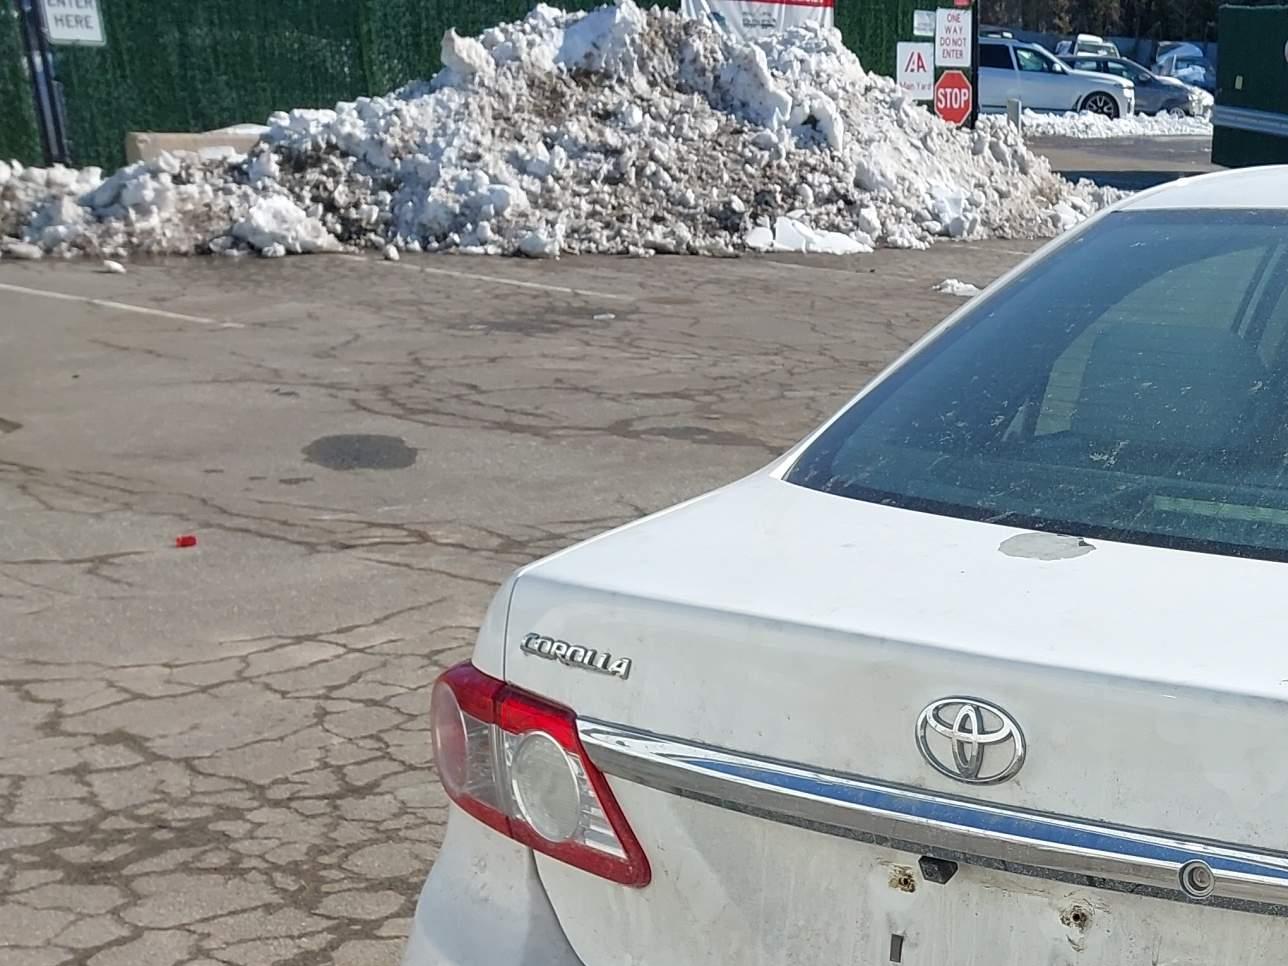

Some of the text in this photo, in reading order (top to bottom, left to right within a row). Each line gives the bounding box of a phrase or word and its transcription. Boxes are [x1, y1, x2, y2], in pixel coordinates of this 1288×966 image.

[54, 14, 94, 29] HERE
[947, 13, 961, 23] ONE
[945, 26, 963, 35] WAY
[940, 38, 967, 47] DO NOT
[942, 49, 963, 59] ENTER
[937, 88, 969, 109] STOP
[520, 632, 632, 680] COROLLA
